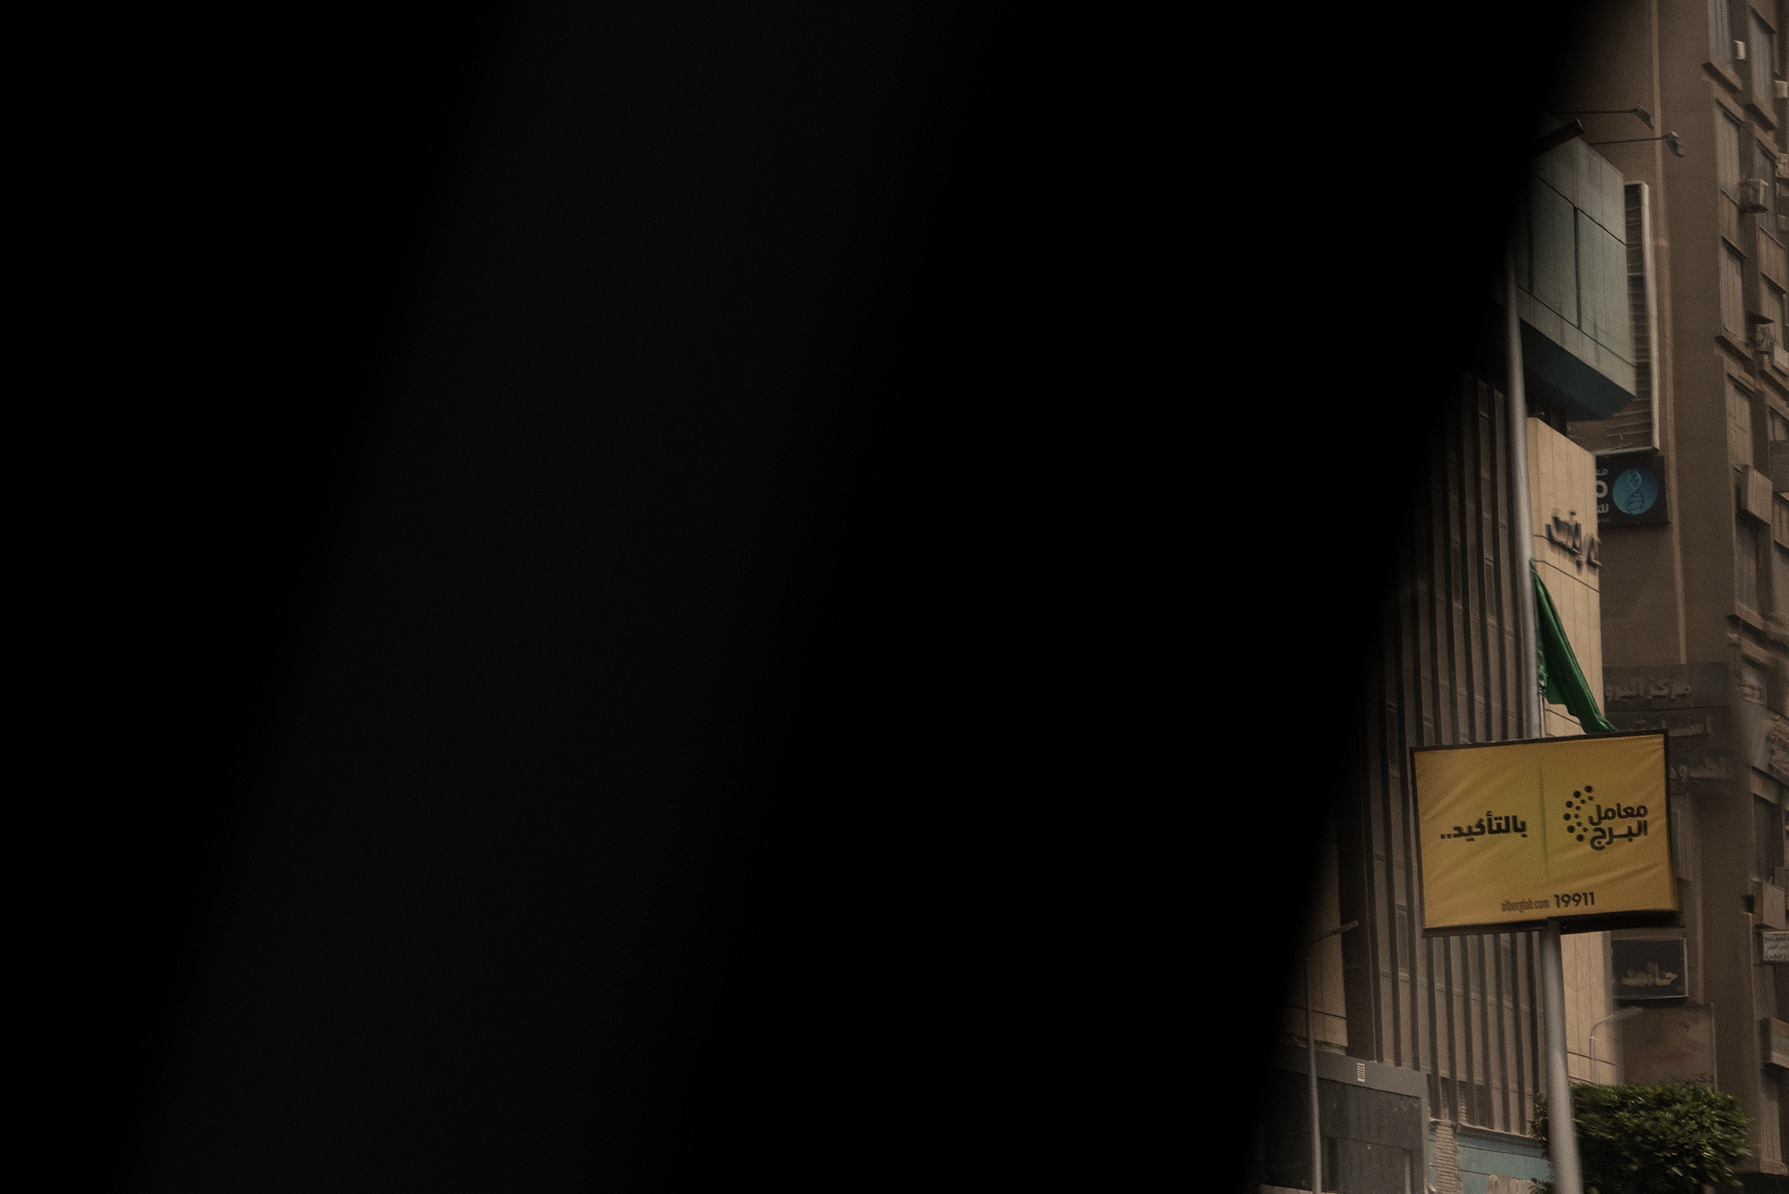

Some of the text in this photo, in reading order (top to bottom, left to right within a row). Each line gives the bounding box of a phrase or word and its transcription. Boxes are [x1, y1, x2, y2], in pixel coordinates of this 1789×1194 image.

[1589, 803, 1649, 826] معامل
[1590, 820, 1648, 850] البرج
[1553, 892, 1595, 908] 19911
